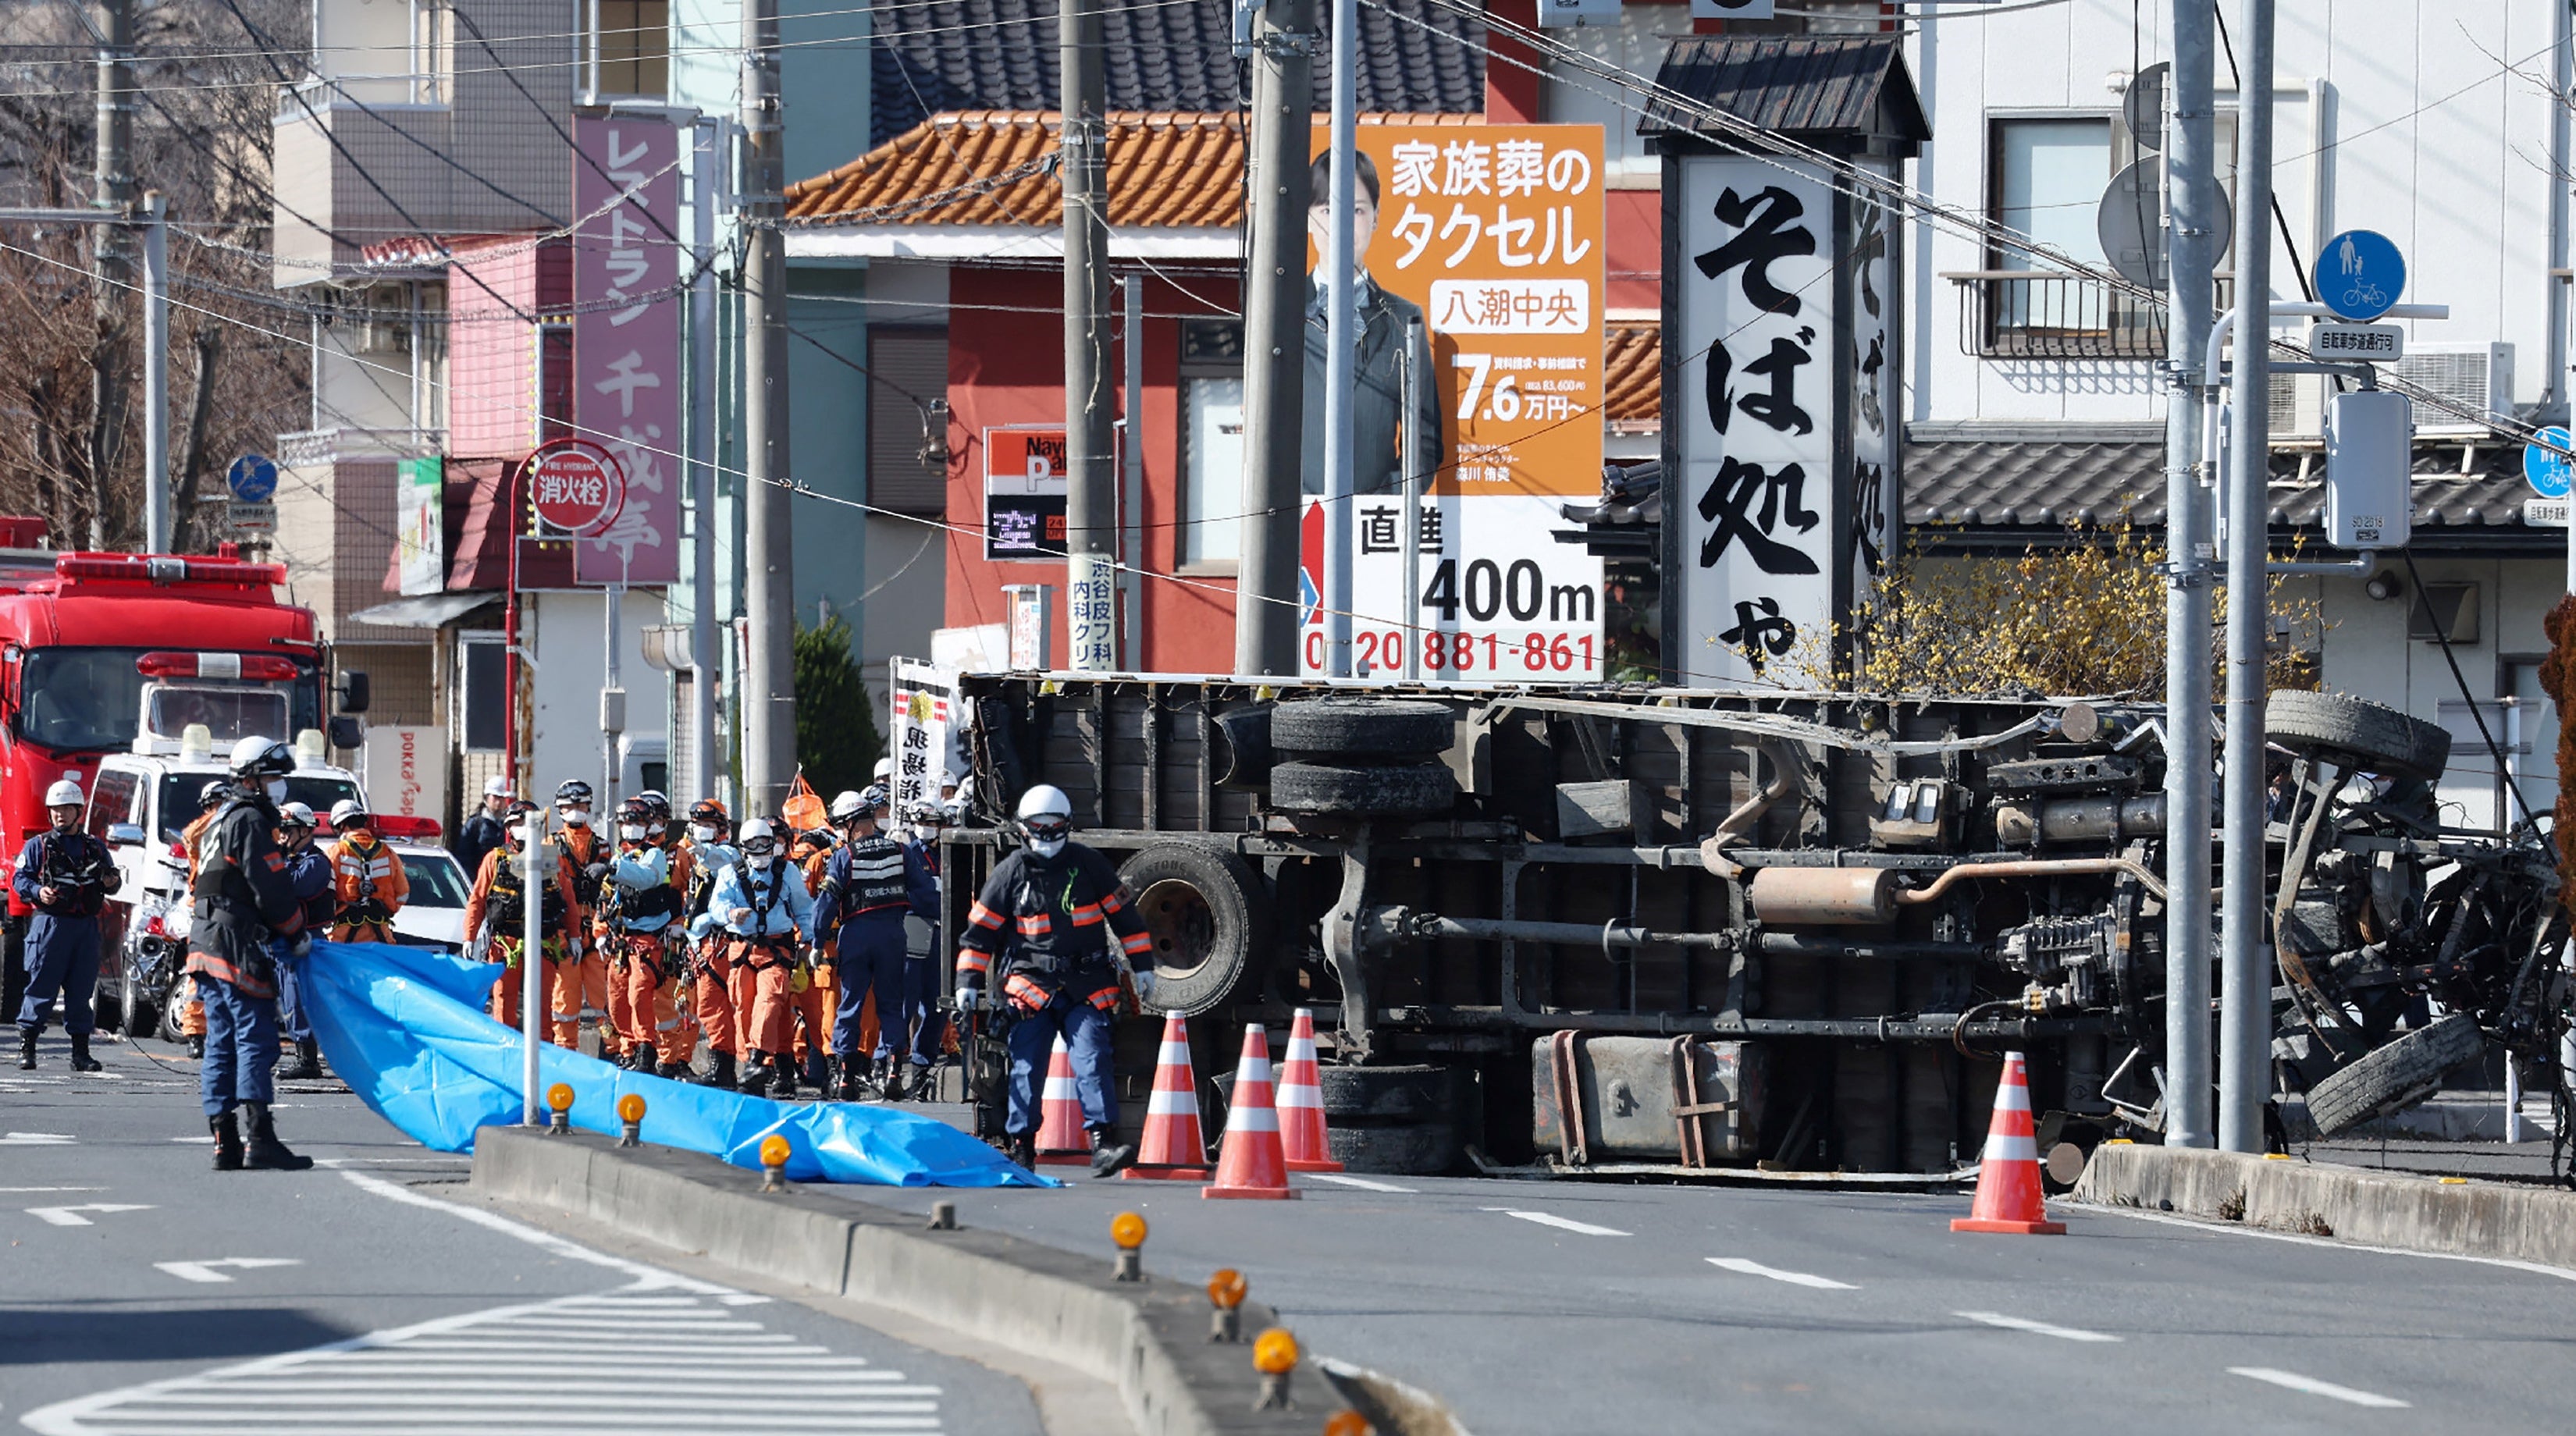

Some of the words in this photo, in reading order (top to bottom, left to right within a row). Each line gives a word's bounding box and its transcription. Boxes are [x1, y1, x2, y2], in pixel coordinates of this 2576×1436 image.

[1392, 138, 1591, 198] 家族葬の
[603, 130, 649, 328] レストラン
[1392, 201, 1591, 269] タクセル
[1440, 287, 1578, 327] 八潮中央
[2321, 332, 2393, 350] 自転車歩道通行可
[1853, 183, 1885, 579] そば処
[1694, 186, 1820, 673] そば処や
[539, 475, 603, 506] 消火栓
[546, 461, 561, 471] FIRE
[563, 461, 596, 471] HYDRANT
[1306, 631, 1403, 670] 020
